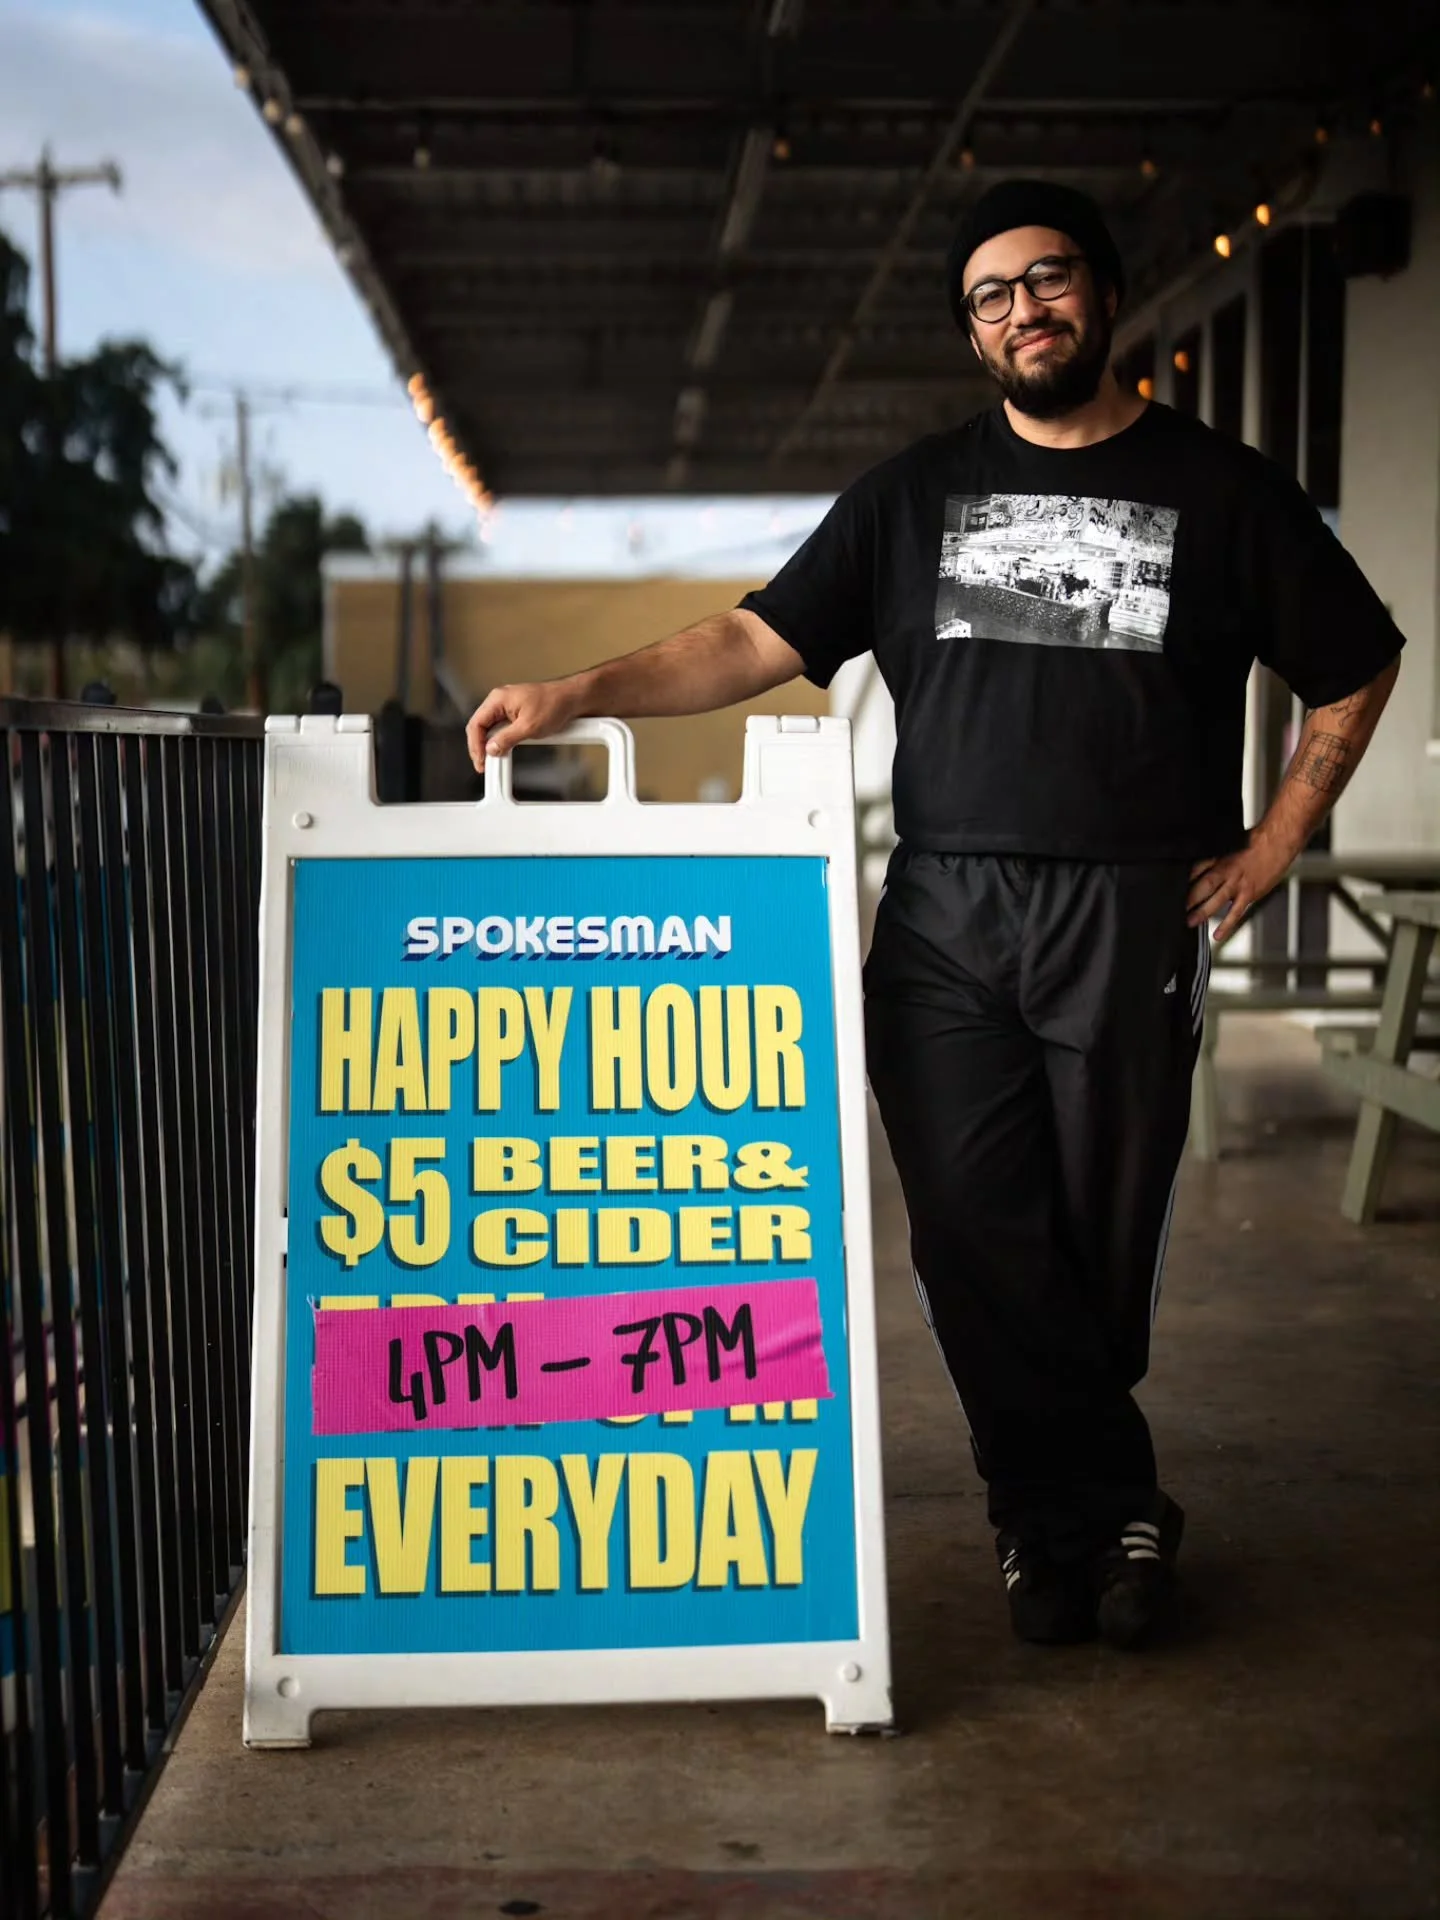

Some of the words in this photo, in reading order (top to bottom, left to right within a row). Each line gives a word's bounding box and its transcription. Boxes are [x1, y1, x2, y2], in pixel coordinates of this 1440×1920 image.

[405, 915, 732, 956] SPOKESMAN
[320, 986, 573, 1112] HAPPY
[591, 983, 806, 1112] HOUR
[320, 1136, 451, 1267] $5
[473, 1205, 812, 1266] CIDER
[388, 1322, 518, 1421] 4PM
[612, 1303, 757, 1394] 7PM
[314, 1448, 818, 1595] EVERYDAY
